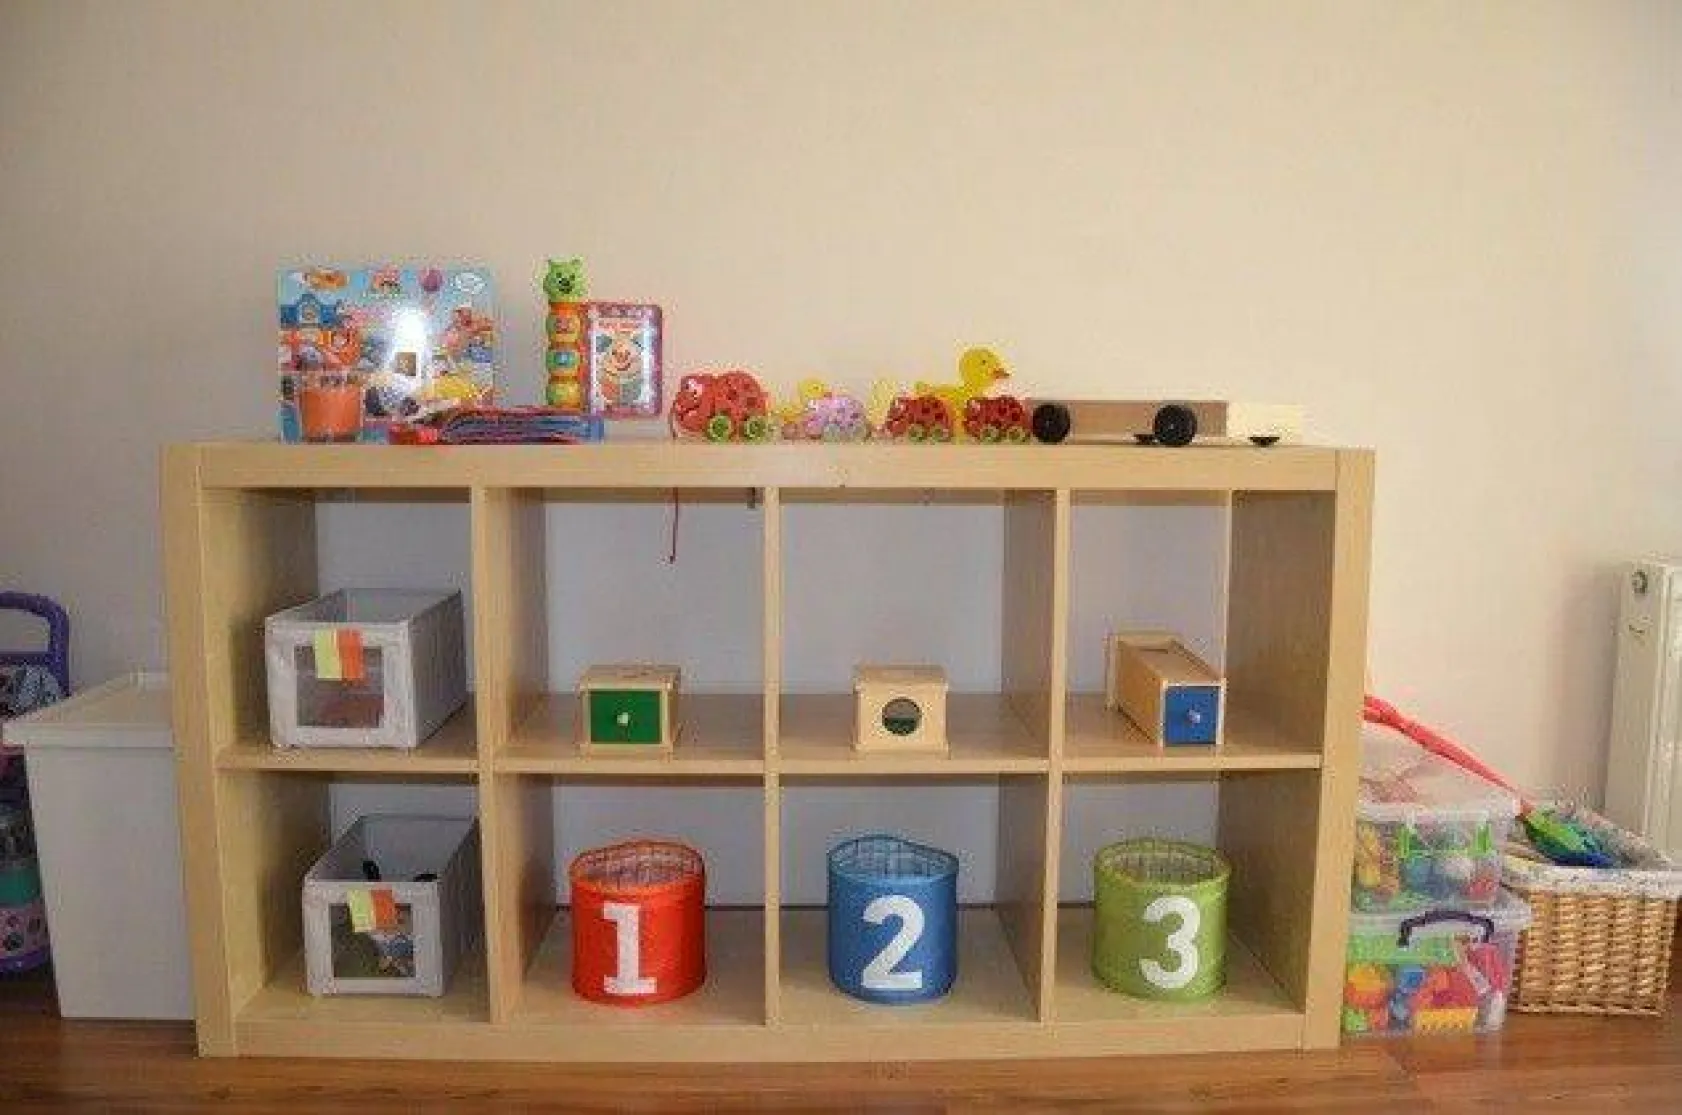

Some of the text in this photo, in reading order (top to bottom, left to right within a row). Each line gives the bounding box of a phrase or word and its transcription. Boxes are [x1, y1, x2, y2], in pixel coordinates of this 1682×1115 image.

[602, 902, 657, 994] 1
[861, 894, 925, 990] 2
[1138, 896, 1201, 989] 3
